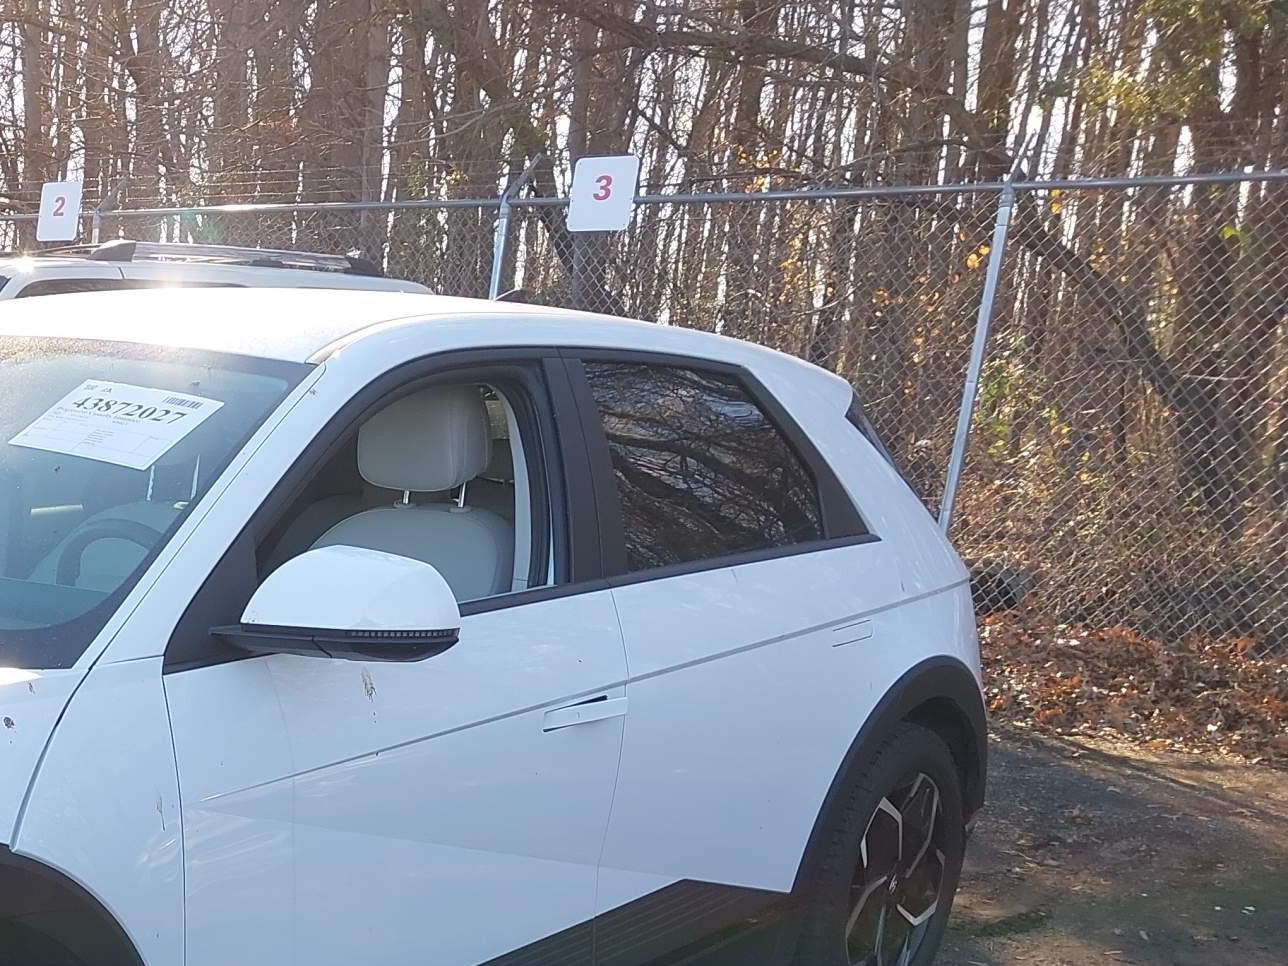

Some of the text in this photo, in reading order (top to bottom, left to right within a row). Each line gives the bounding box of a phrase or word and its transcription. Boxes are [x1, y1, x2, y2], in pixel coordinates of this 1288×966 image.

[593, 175, 613, 201] 3
[52, 196, 66, 217] 2
[72, 396, 188, 424] 43872027
